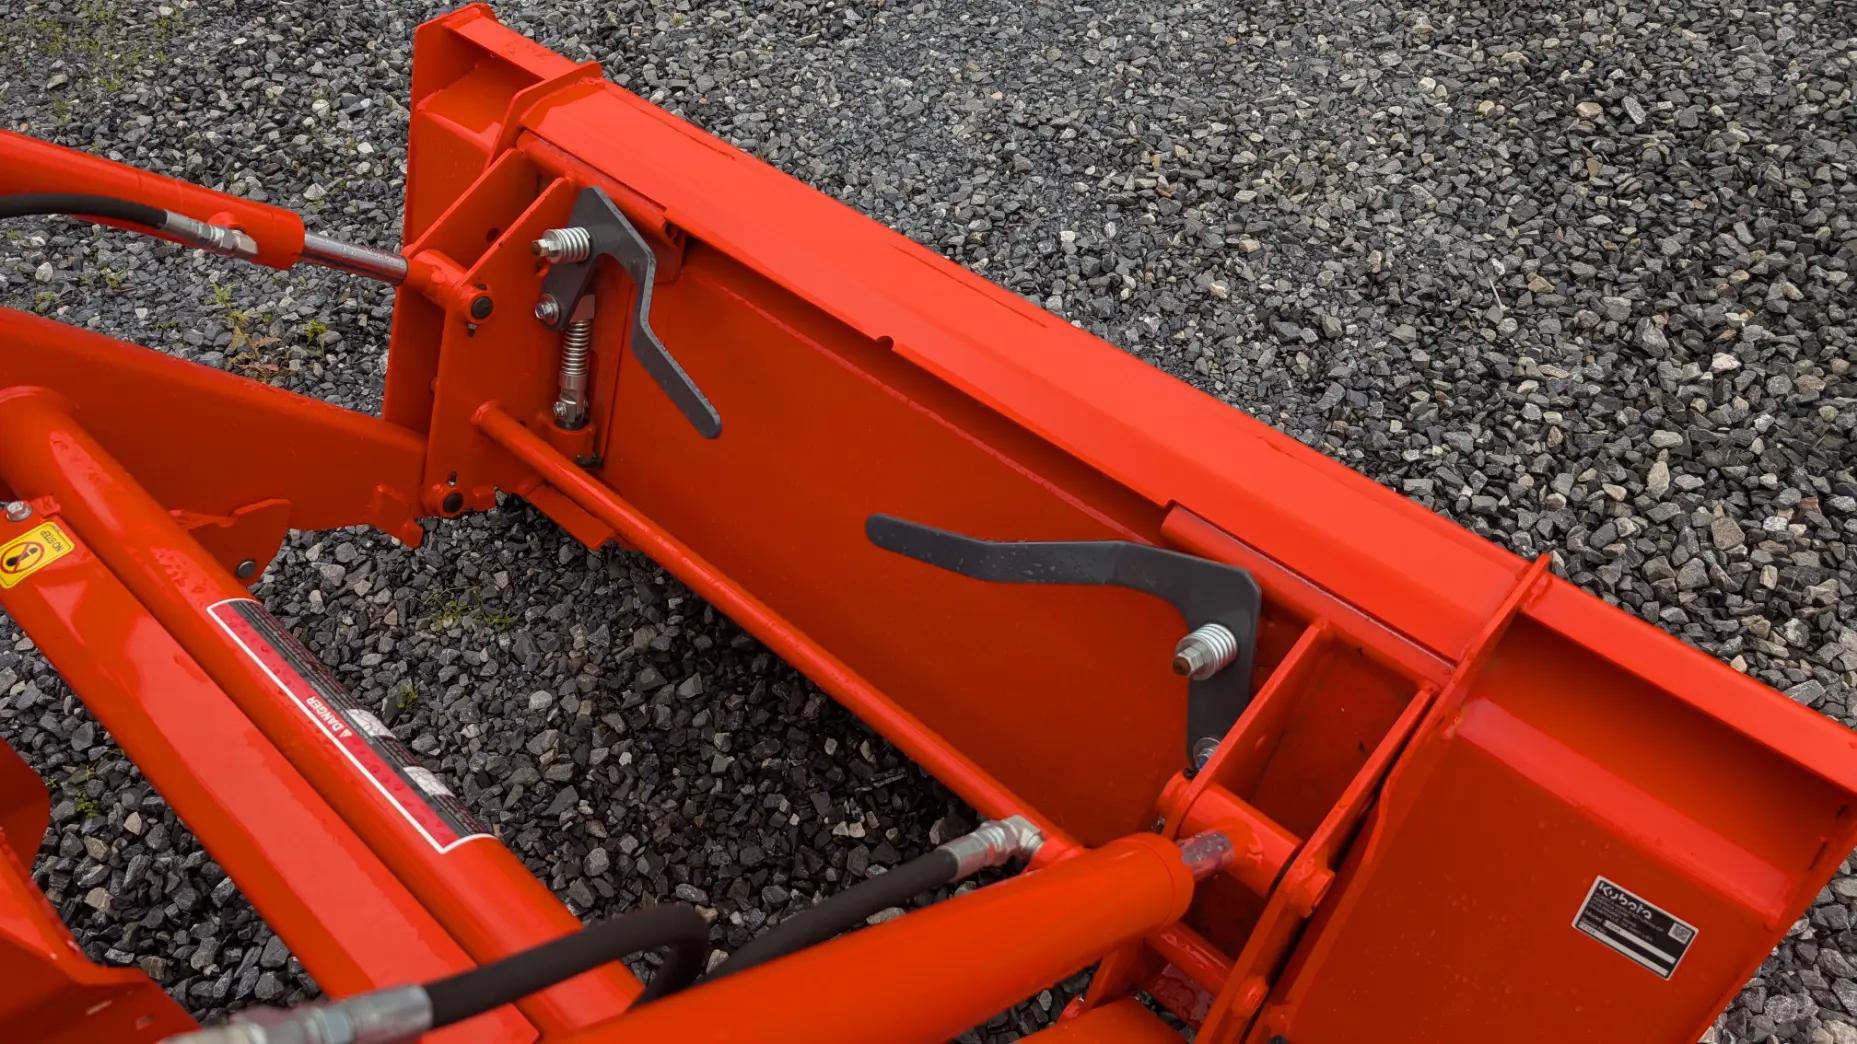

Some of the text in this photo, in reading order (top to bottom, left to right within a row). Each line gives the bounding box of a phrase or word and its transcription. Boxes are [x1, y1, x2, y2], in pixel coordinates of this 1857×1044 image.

[40, 530, 65, 552] NO STEP
[306, 696, 345, 731] DANGER
[1598, 882, 1653, 920] Kubota
